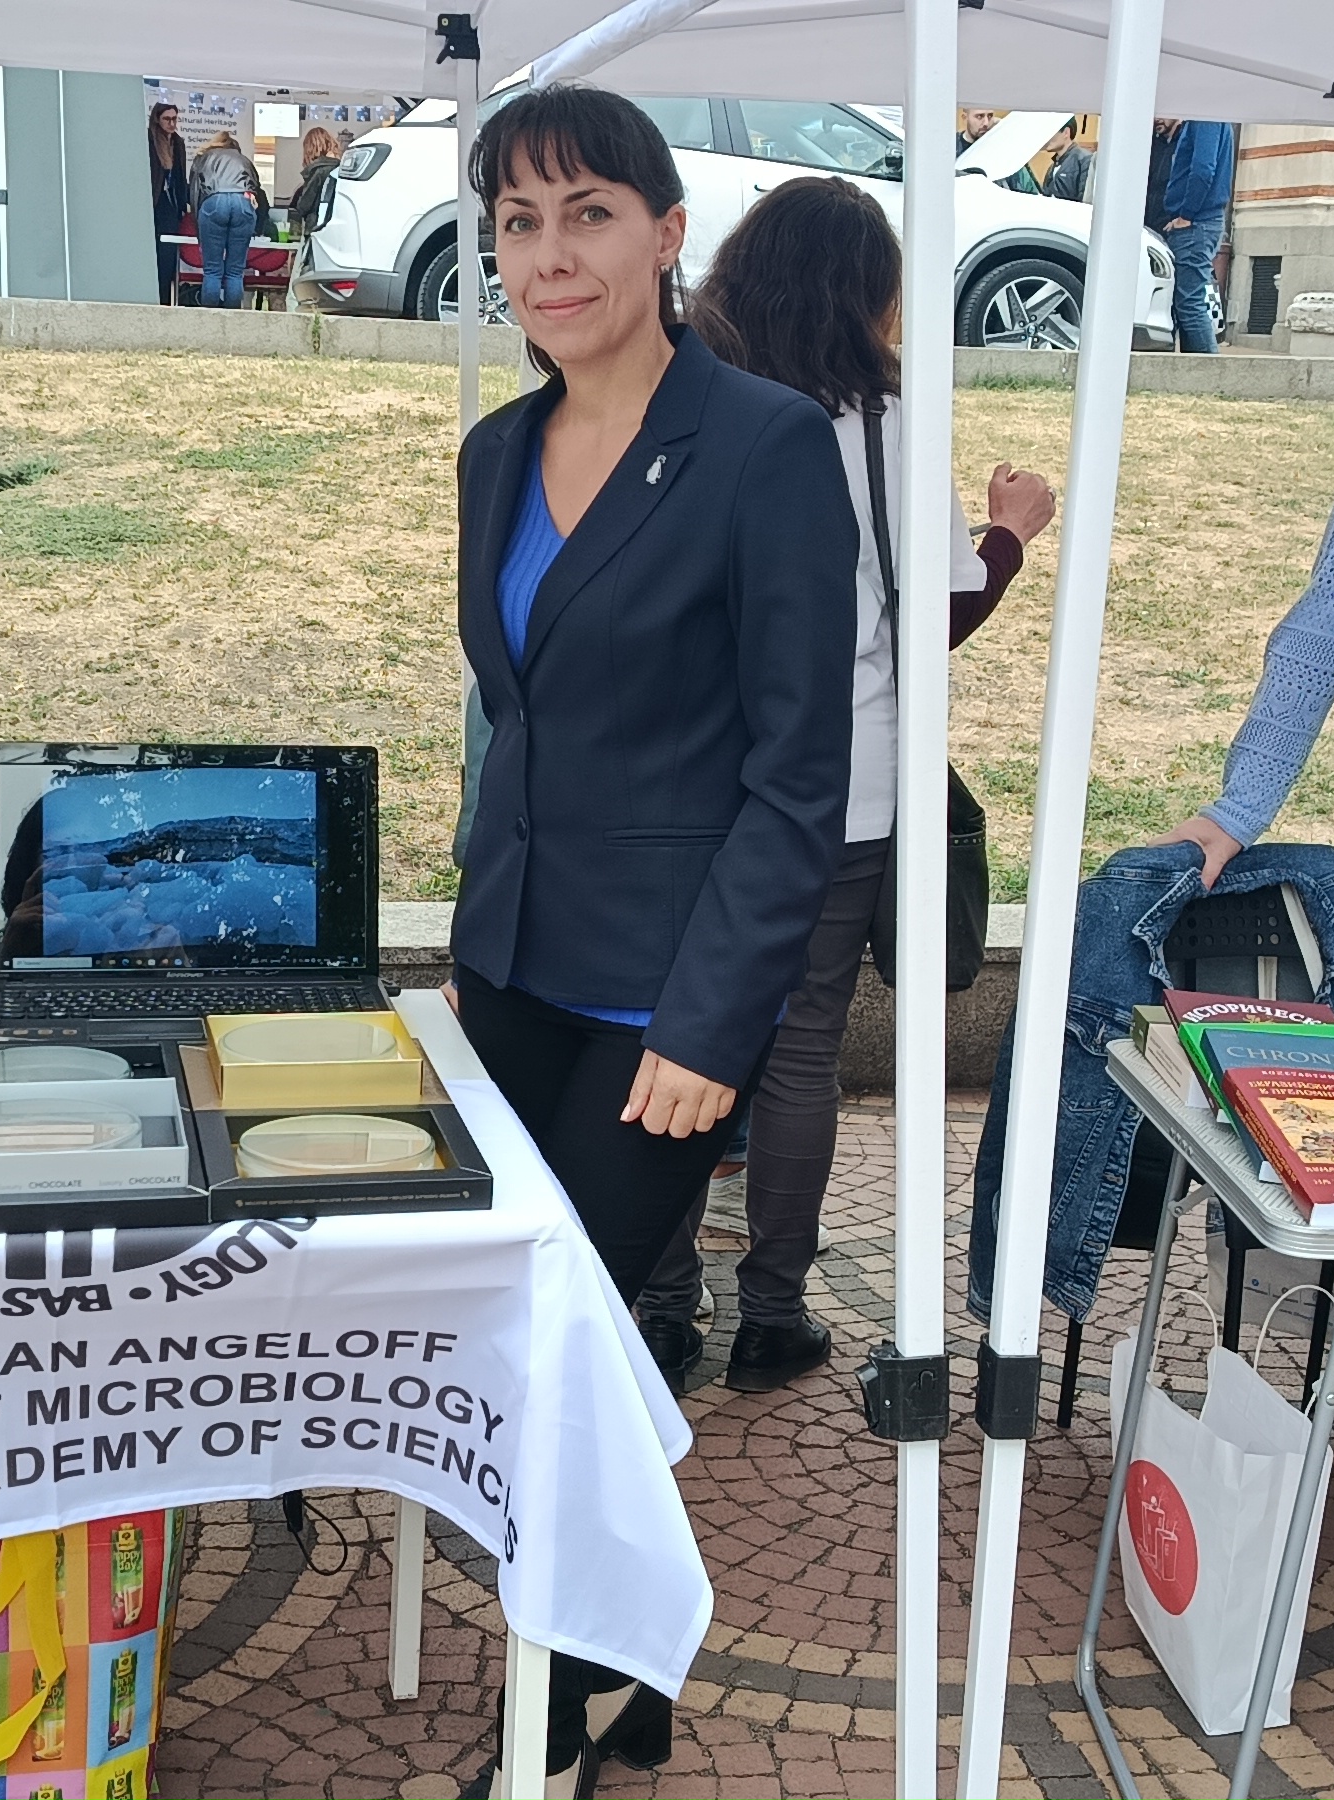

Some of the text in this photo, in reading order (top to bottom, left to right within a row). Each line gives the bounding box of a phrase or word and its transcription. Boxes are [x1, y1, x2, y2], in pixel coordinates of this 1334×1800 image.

[204, 118, 237, 128] Heritage
[29, 1180, 82, 1189] CHOCOLATE
[129, 1175, 182, 1186] CHOCOLATE
[0, 1284, 113, 1318] BAS
[108, 1329, 458, 1367] ANGELOFF
[27, 1372, 504, 1445] MICROBIOLOGY
[201, 1419, 282, 1457] OF
[301, 1416, 519, 1565] SCIENCS
